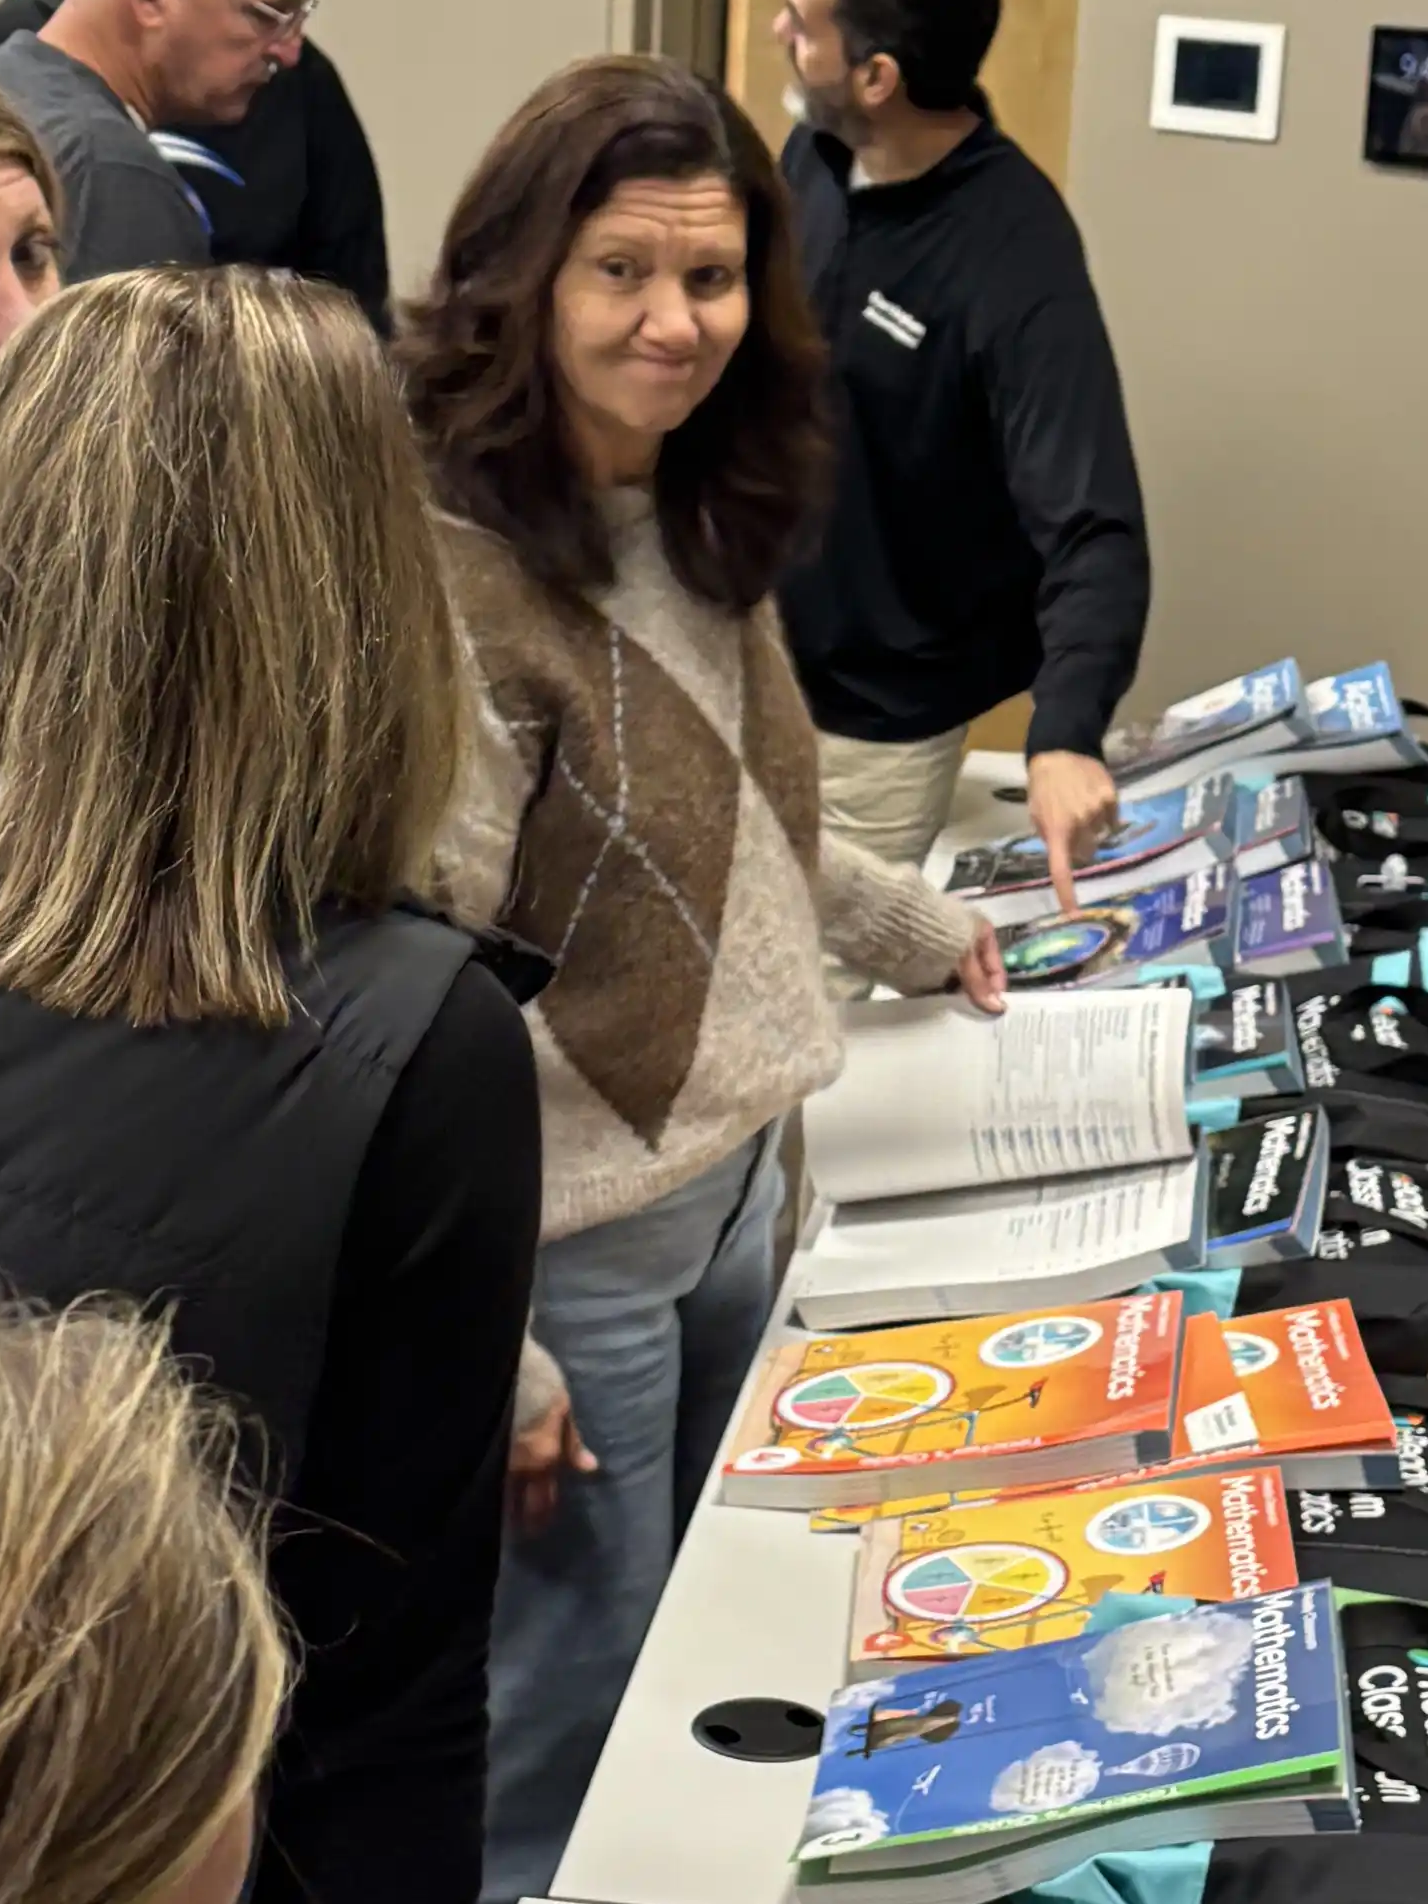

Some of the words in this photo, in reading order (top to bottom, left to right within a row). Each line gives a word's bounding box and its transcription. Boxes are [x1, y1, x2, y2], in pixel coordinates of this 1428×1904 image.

[1106, 1296, 1155, 1400] Mathematics
[1284, 1309, 1347, 1410] Mathematics
[1221, 1475, 1268, 1598] Mathematics
[1252, 1590, 1301, 1740] Mathematics
